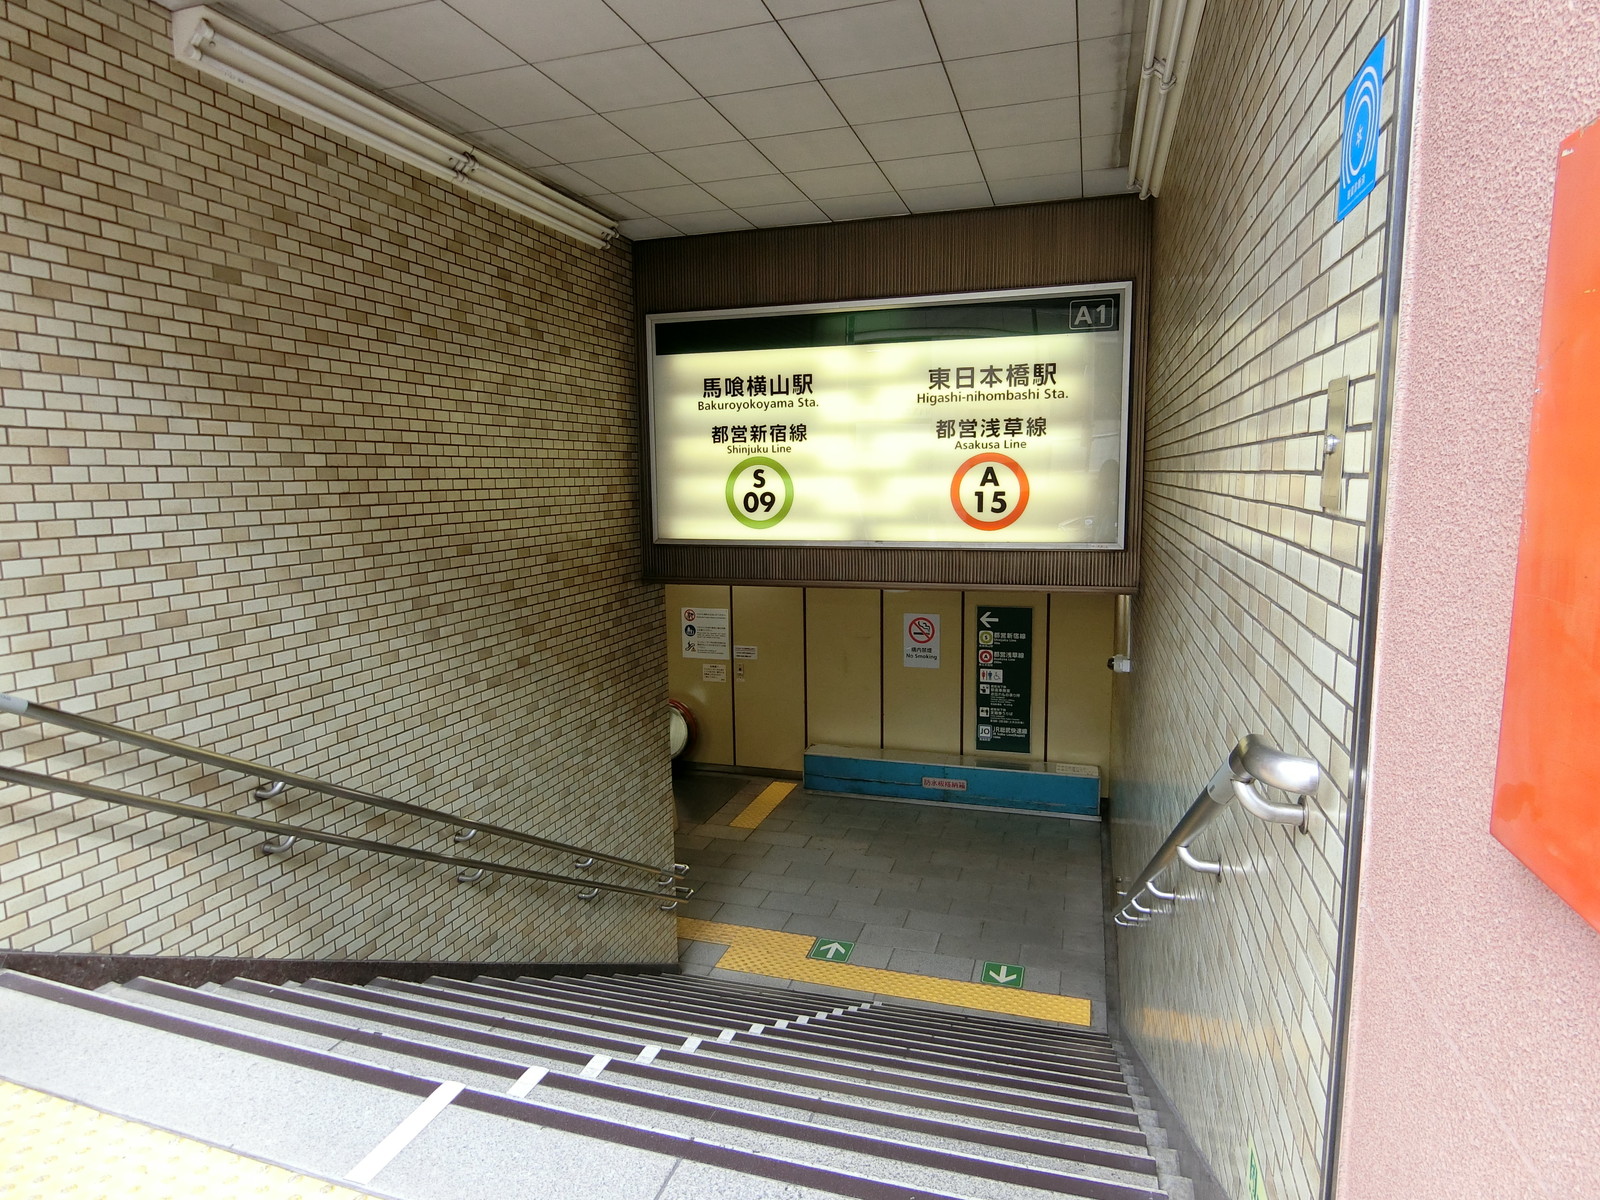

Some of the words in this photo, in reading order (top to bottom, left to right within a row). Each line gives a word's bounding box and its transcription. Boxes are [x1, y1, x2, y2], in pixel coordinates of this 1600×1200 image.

[1073, 304, 1106, 325] A1
[702, 373, 813, 399] 馬喰横山駅
[928, 362, 1057, 390] 東日本橋駅
[698, 398, 794, 412] Bakuroyokoyama
[797, 397, 819, 408] Sta.
[917, 388, 1040, 406] Higashi-nihombashi
[1044, 388, 1069, 400] Sta.
[711, 423, 807, 444] 都営新宿線
[936, 416, 1047, 439] 都営浅草線
[727, 445, 769, 456] Shinjuku
[771, 444, 792, 454] Line
[954, 440, 1000, 450] Asakusa
[1003, 439, 1027, 449] Line
[753, 468, 766, 488] S
[979, 466, 1000, 487] A
[743, 491, 776, 513] 09
[974, 491, 1007, 514] 15
[915, 653, 938, 661] Smoking
